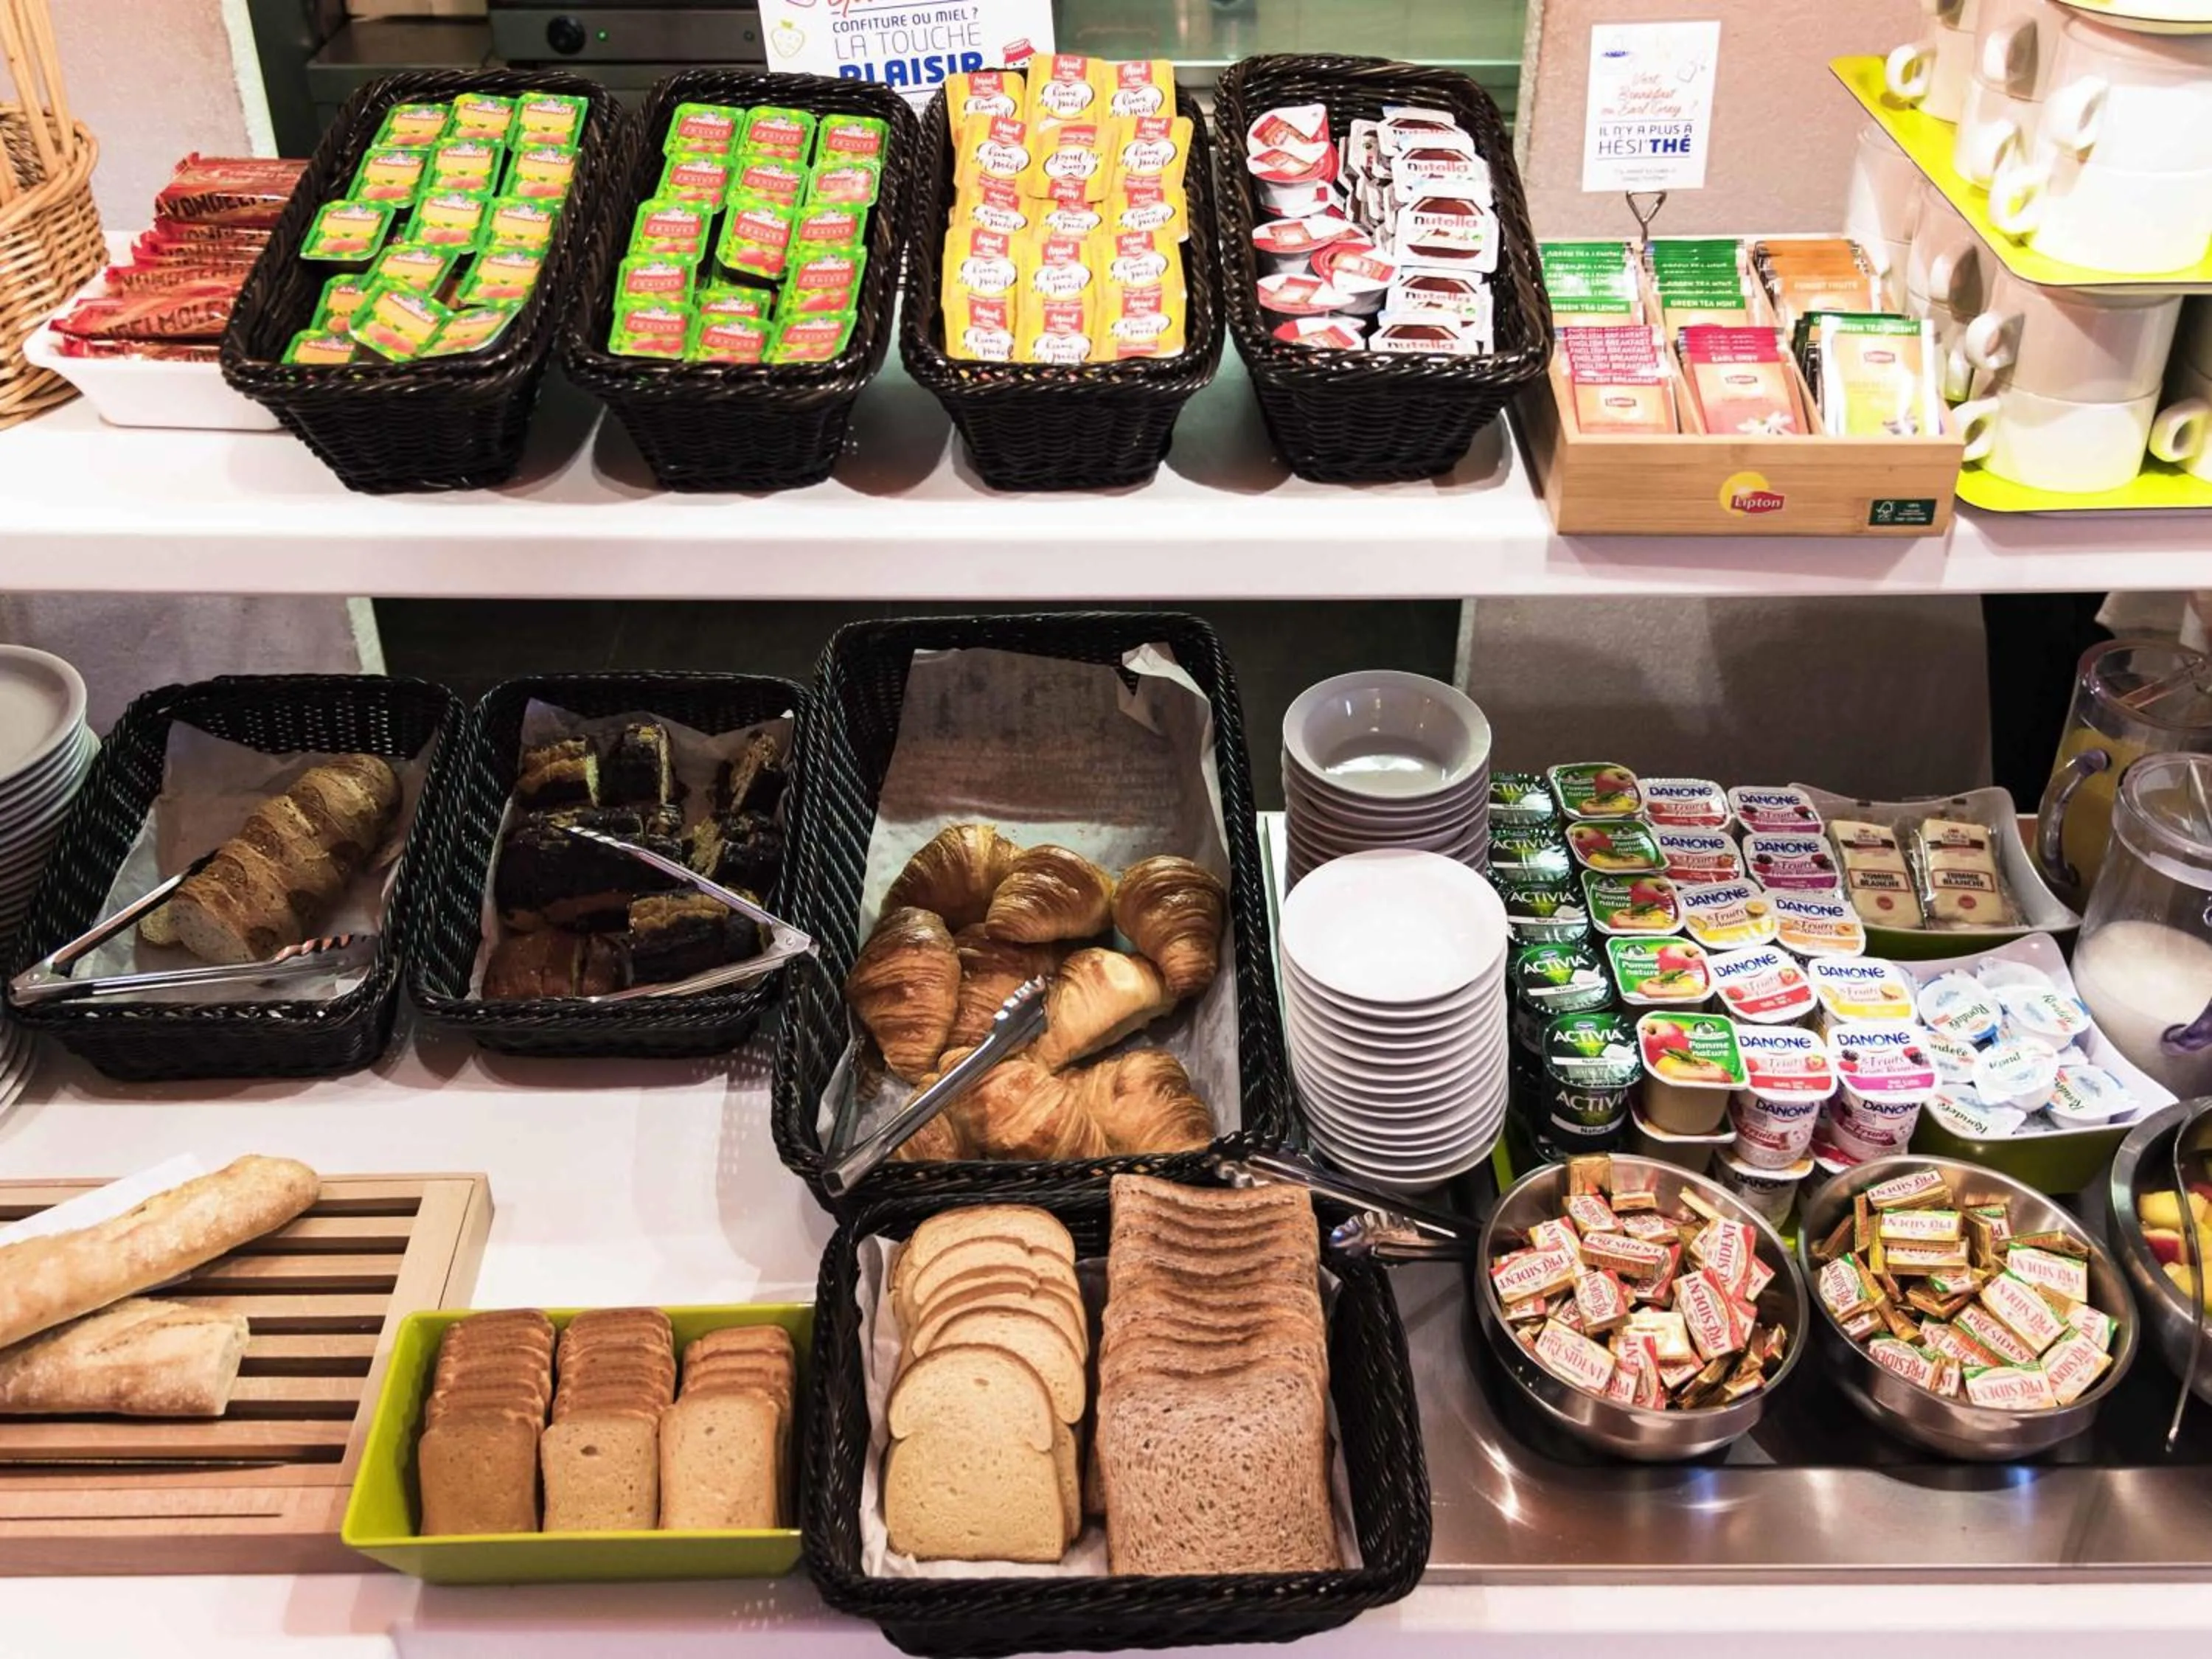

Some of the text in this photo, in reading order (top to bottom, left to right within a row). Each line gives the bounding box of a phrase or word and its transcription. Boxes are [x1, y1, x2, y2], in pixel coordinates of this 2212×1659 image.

[832, 7, 979, 33] CONFITURE OU MIEL ?
[834, 22, 981, 60] LA TOUCHE
[1649, 125, 1680, 135] PLUS
[1407, 161, 1469, 173] nutella
[1414, 216, 1478, 227] nutella
[1405, 291, 1470, 304] nutella
[1387, 341, 1454, 351] nutella
[1734, 495, 1781, 509] Lipton
[1491, 782, 1541, 793] CTIVIA
[1649, 787, 1712, 796] DANONE
[1739, 795, 1800, 804] DANONE
[1493, 839, 1556, 850] ACTIVIA
[1660, 835, 1725, 849] DANONE
[1754, 841, 1819, 852] DANONE
[1510, 891, 1576, 903] ACTIVIA
[1684, 887, 1750, 908] DANONE
[1776, 898, 1844, 917] DANONE
[1523, 955, 1589, 974] ACTIVIA
[1714, 953, 1779, 977] DANONE
[1818, 965, 1885, 978] DANONE
[1554, 1029, 1625, 1043] ACTIVIA
[1739, 1035, 1811, 1049] DANONE
[1837, 1032, 1910, 1046] DANONE
[1688, 1041, 1729, 1050] Pomme
[1555, 1090, 1622, 1111] ACTIVI
[1863, 1100, 1916, 1114] DANON
